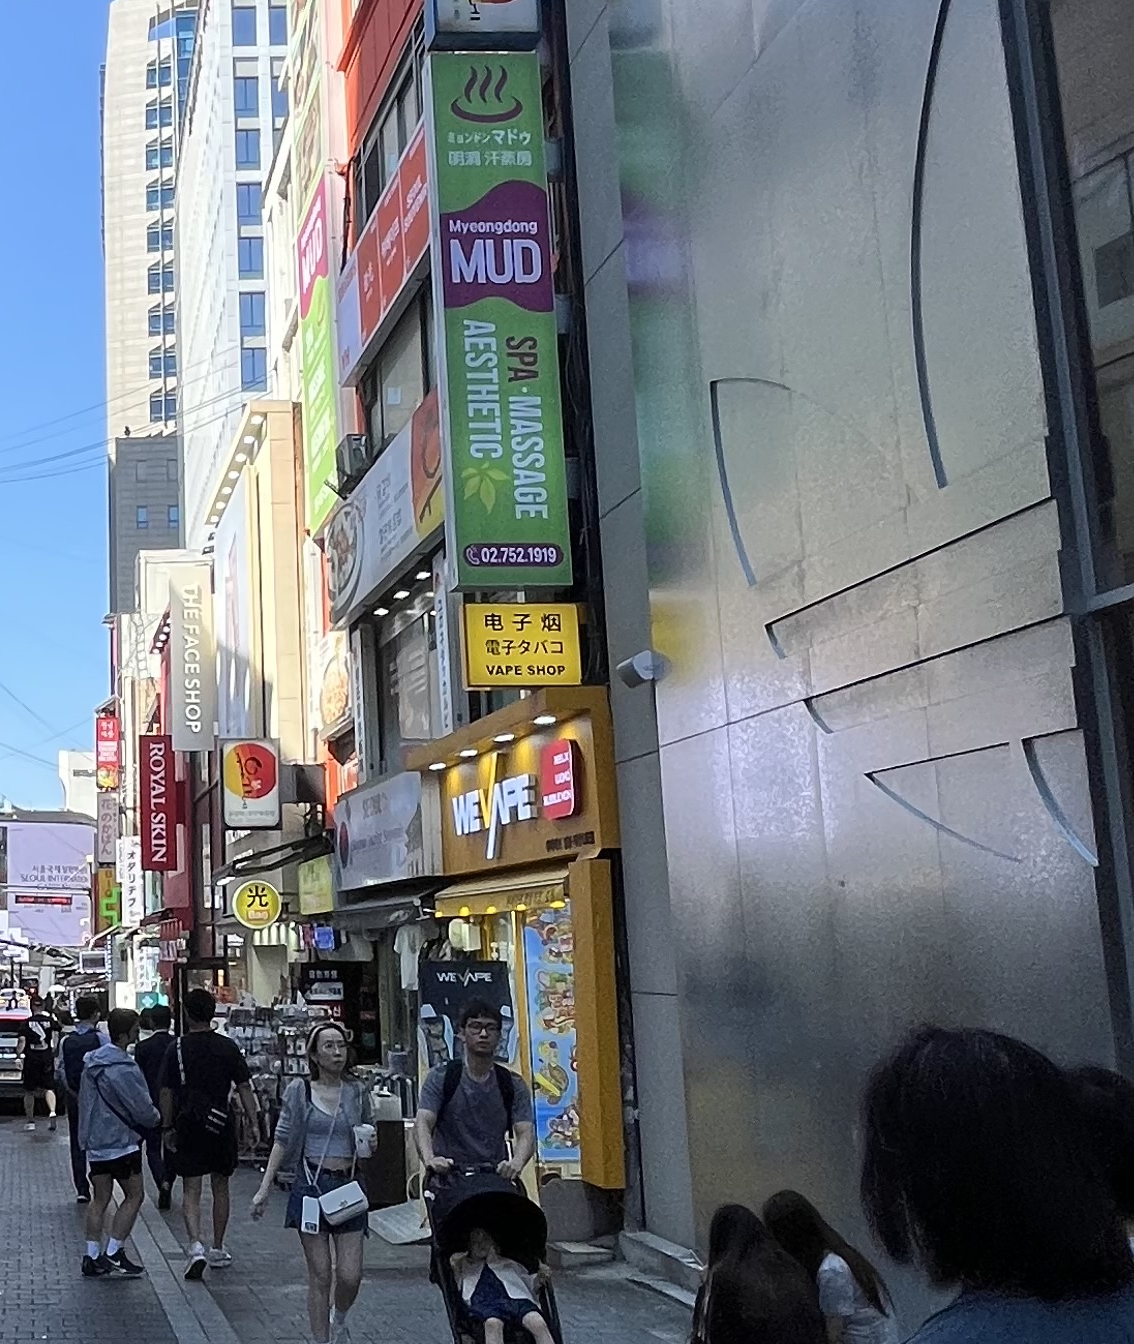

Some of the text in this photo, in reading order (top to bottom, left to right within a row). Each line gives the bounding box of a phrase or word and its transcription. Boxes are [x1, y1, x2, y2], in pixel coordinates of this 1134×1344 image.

[449, 219, 538, 235] Myeongdong
[449, 238, 543, 284] MUD
[463, 319, 504, 459] AESTHETIC
[505, 335, 549, 519] SPA MASSAGE
[481, 546, 557, 564] 02.752.1919
[180, 583, 202, 734] THE FACE SHOP
[485, 639, 564, 656] 電子タバコ
[485, 664, 566, 676] VAPE SHOP
[149, 742, 168, 863] ROYAL SKIN
[246, 885, 270, 908] 光
